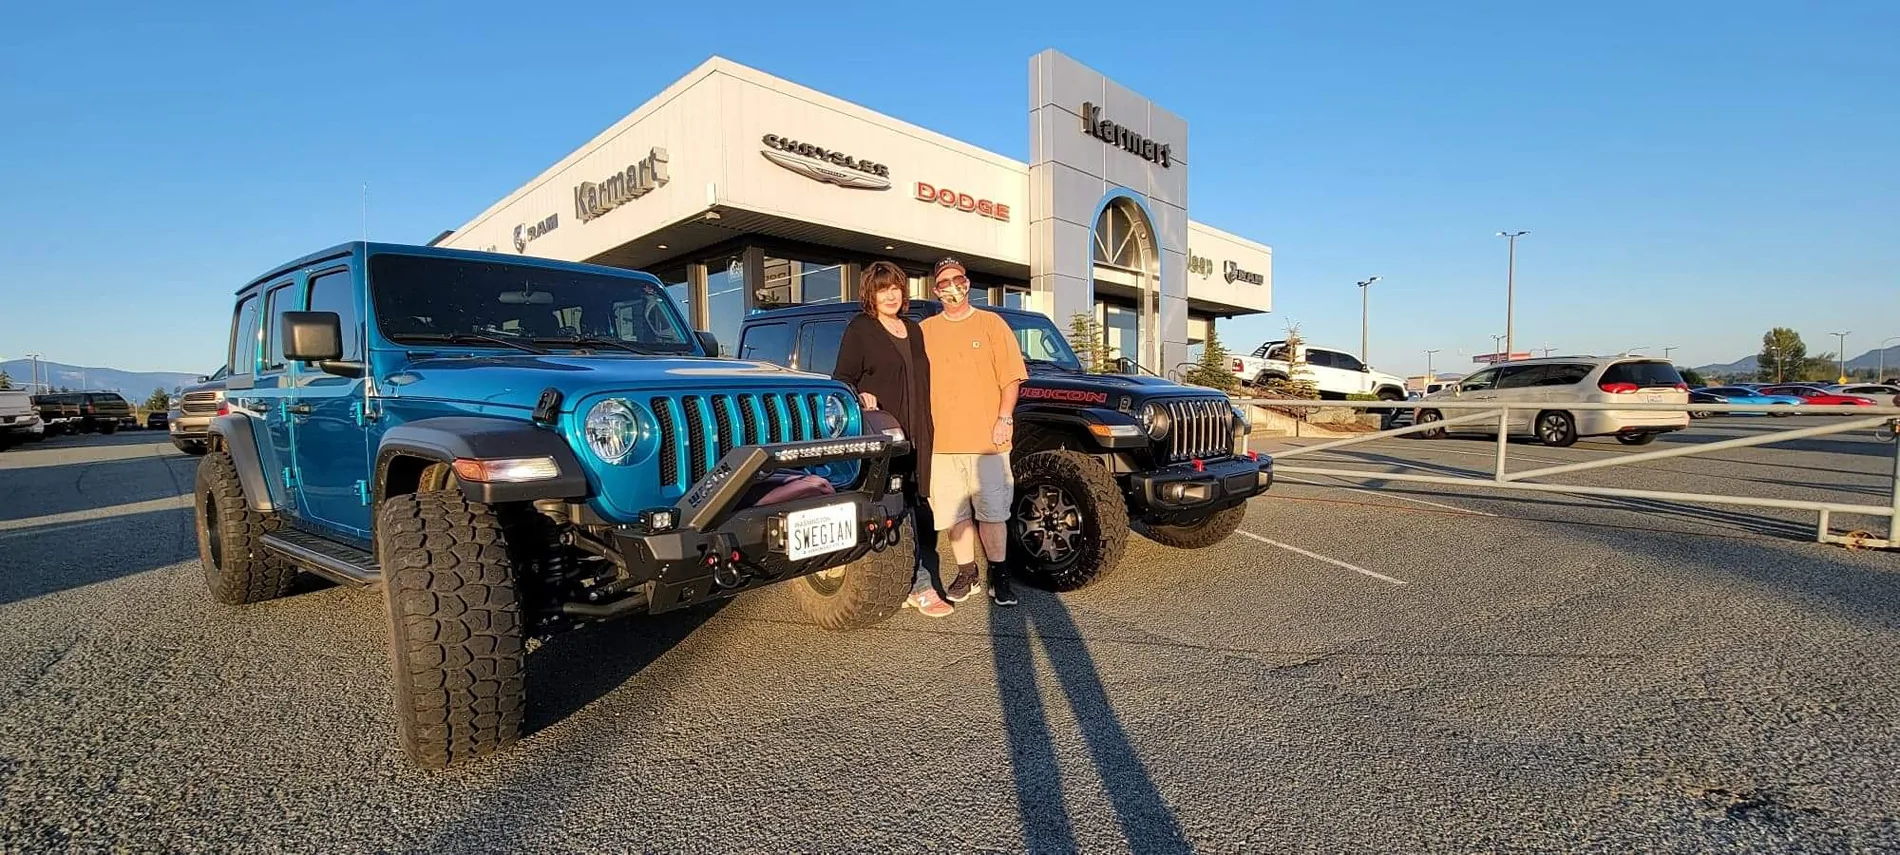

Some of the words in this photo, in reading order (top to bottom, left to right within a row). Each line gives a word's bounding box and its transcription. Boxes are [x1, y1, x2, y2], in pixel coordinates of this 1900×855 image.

[1082, 101, 1171, 168] Karmart
[762, 133, 890, 178] CHRYSLER
[573, 147, 669, 224] Karmart
[914, 181, 1011, 222] DODGE
[526, 212, 559, 242] RAM
[1187, 247, 1213, 280] Jeep
[1019, 387, 1108, 403] UBICON
[794, 519, 853, 551] SWEGIAN
